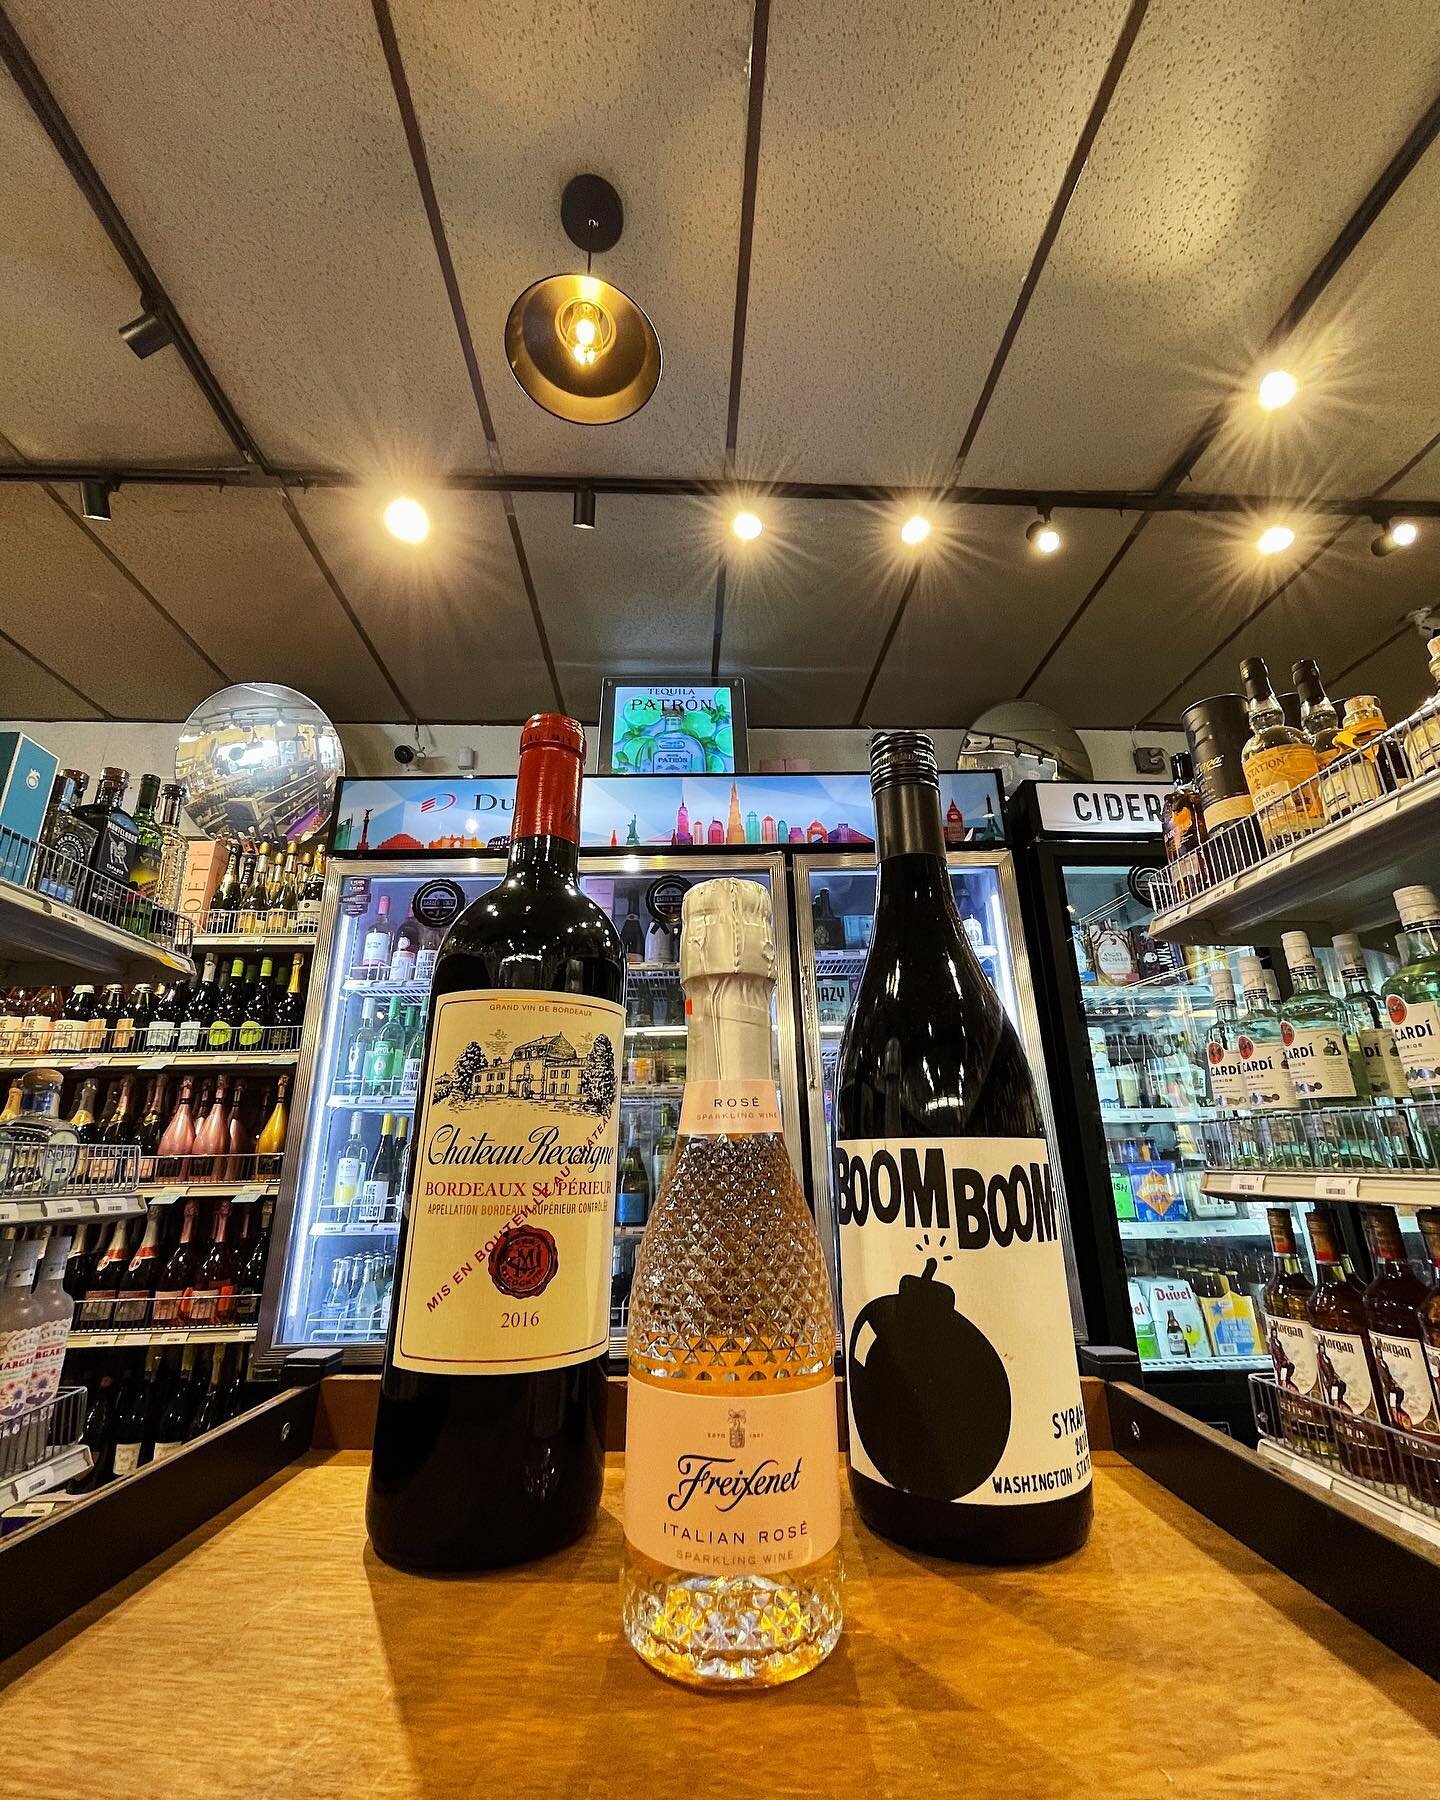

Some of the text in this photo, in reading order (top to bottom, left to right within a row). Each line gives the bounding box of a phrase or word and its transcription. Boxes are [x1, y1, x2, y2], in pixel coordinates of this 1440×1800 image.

[648, 688, 695, 696] TEQUILA
[631, 696, 713, 711] PATRÓN
[490, 1003, 593, 1017] GRAND VIN DE BORDEAUX
[714, 1097, 760, 1108] ROSÉ
[696, 1113, 754, 1121] SPARKLING
[428, 1124, 525, 1166] Château
[425, 1177, 612, 1197] BORDEAUX SUPÉRIEUR
[832, 1147, 1058, 1250] BOOM BOOM
[427, 1203, 478, 1216] APPELLATION
[481, 1204, 530, 1217] BORDEAUX
[532, 1201, 577, 1216] SUPÉRIEUR
[426, 1284, 452, 1312] MIS
[452, 1261, 473, 1285] EN
[474, 1188, 552, 1264] BOUTEILLE
[553, 1165, 571, 1188] AU
[1155, 1287, 1192, 1301] Duvel
[500, 1311, 540, 1328] 2016
[1272, 1319, 1304, 1339] Morgan
[1318, 1334, 1355, 1354] Morgan
[1374, 1336, 1413, 1359] Morgan
[668, 1454, 803, 1512] Freixenet
[992, 1467, 1073, 1494] WASHINGTON
[663, 1520, 808, 1545] ITALIAN ROSÉ
[676, 1549, 793, 1566] SPARKLING WINE
